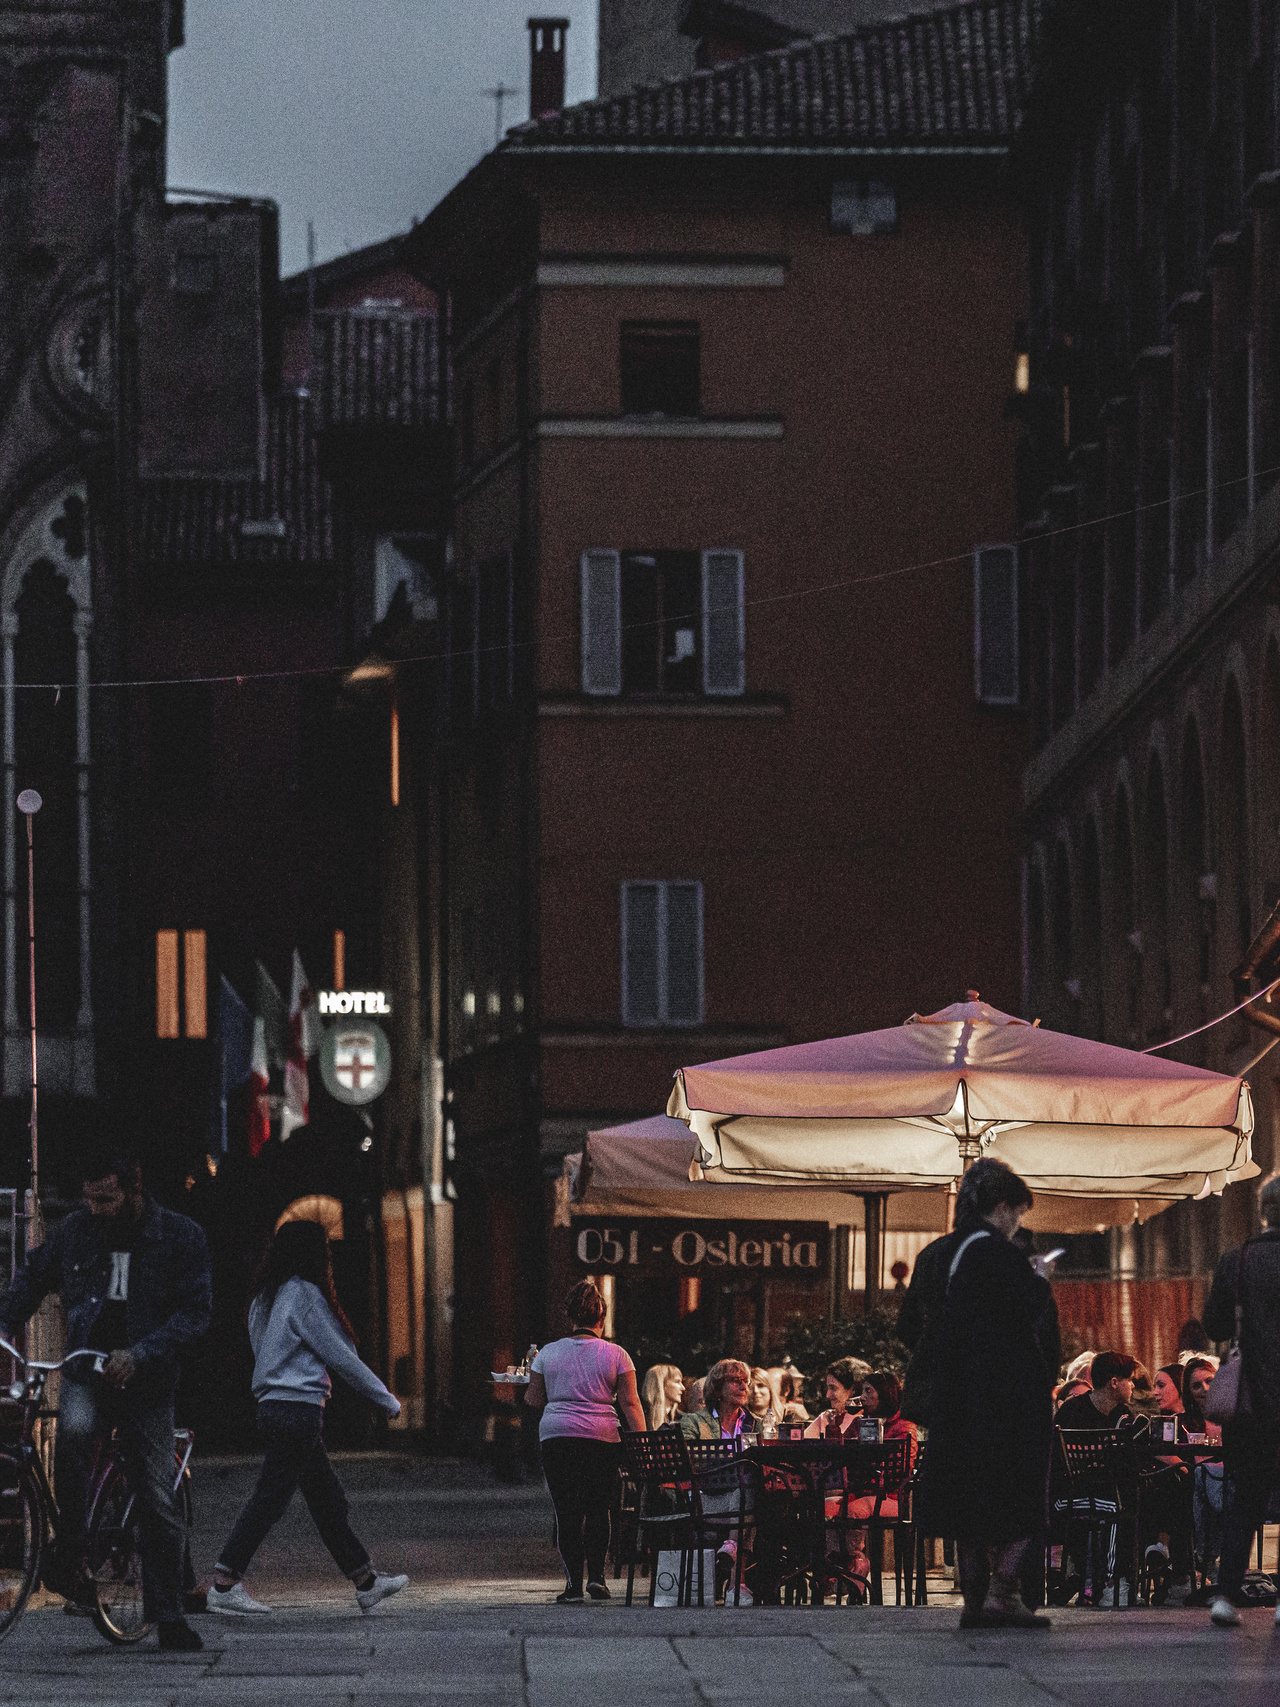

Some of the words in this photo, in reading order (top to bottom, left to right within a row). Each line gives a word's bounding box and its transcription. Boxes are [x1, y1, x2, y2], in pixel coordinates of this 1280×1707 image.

[319, 991, 390, 1014] HOTEL
[577, 1228, 640, 1264] 051
[671, 1230, 820, 1268] Osteria
